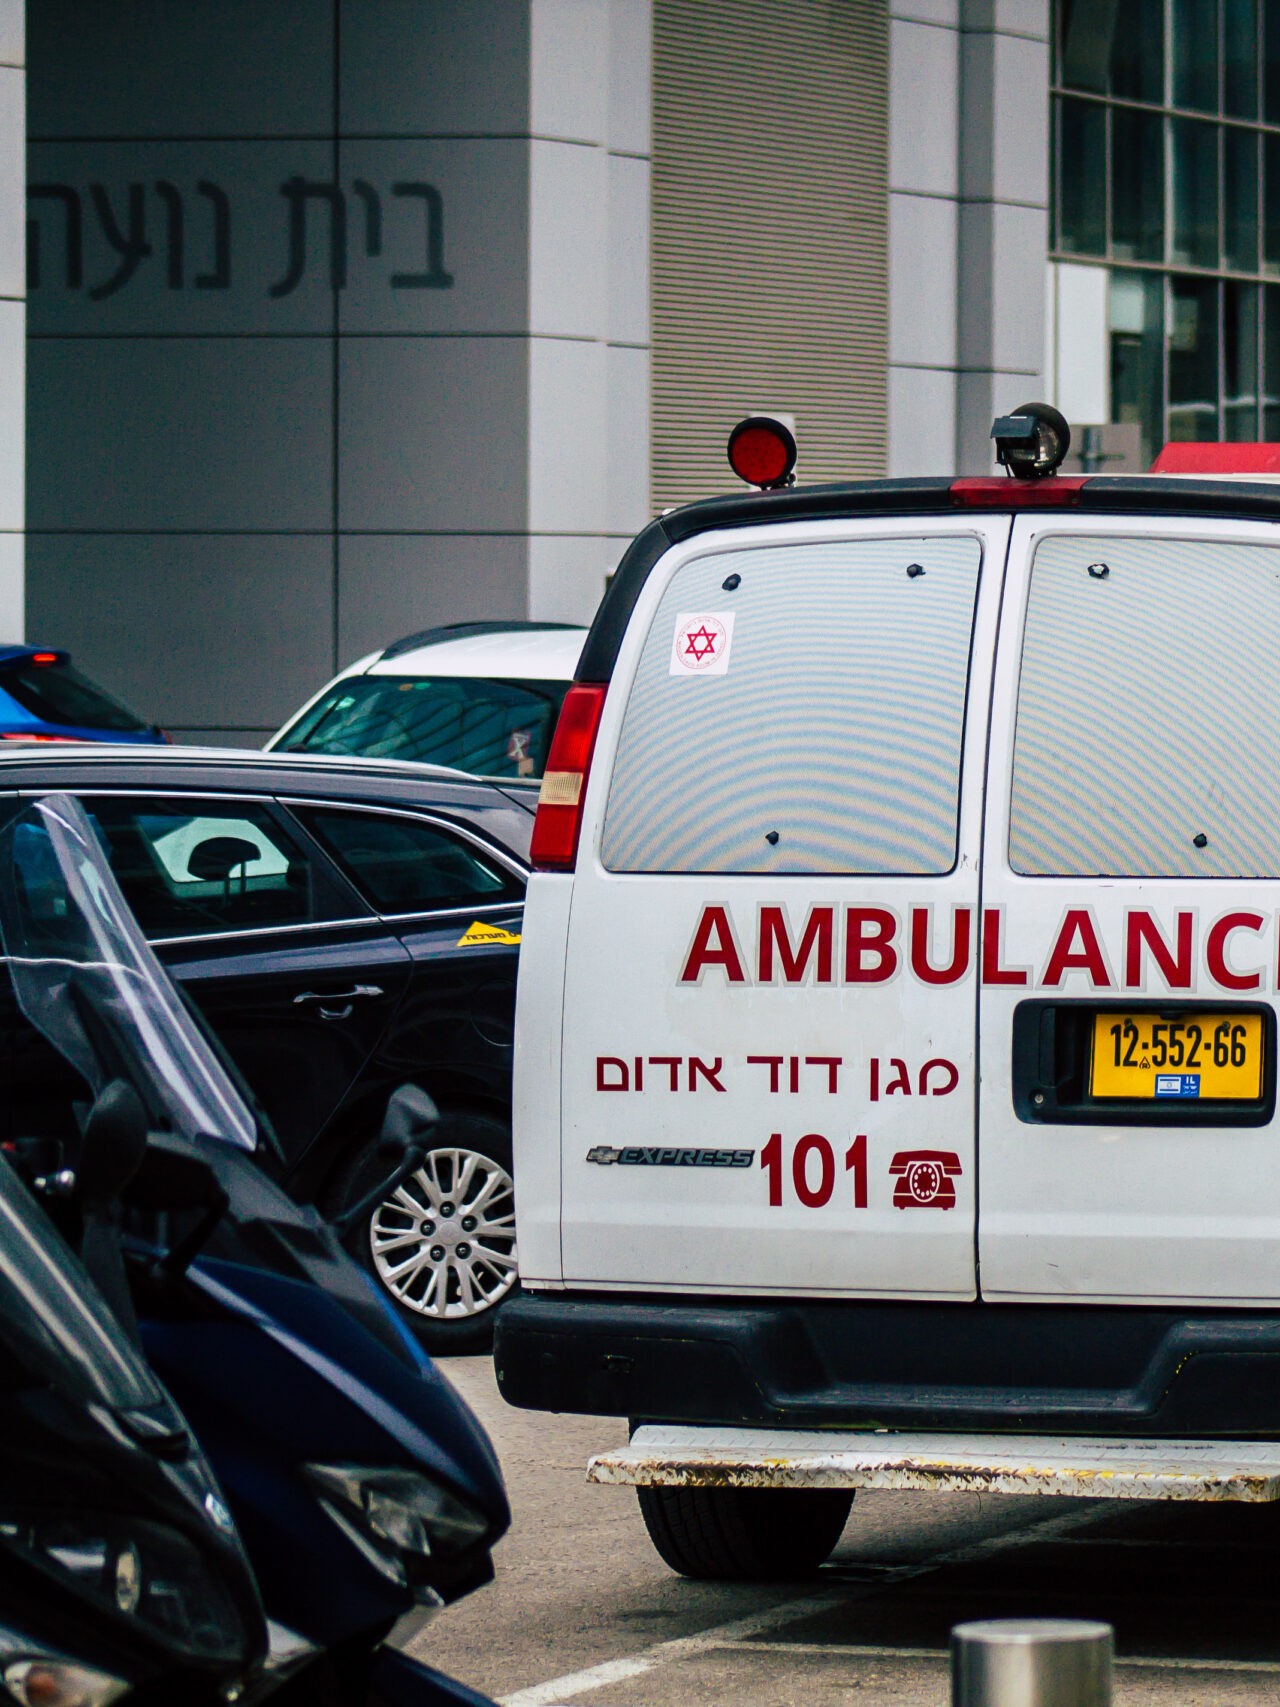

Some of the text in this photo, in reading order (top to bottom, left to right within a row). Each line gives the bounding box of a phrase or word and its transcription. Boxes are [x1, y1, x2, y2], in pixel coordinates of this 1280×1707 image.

[270, 177, 454, 298] בית
[596, 1056, 960, 1102] מגן דוד אדום
[1185, 1076, 1196, 1085] IL
[621, 1146, 755, 1169] EXPRESS
[760, 1133, 869, 1209] 101
